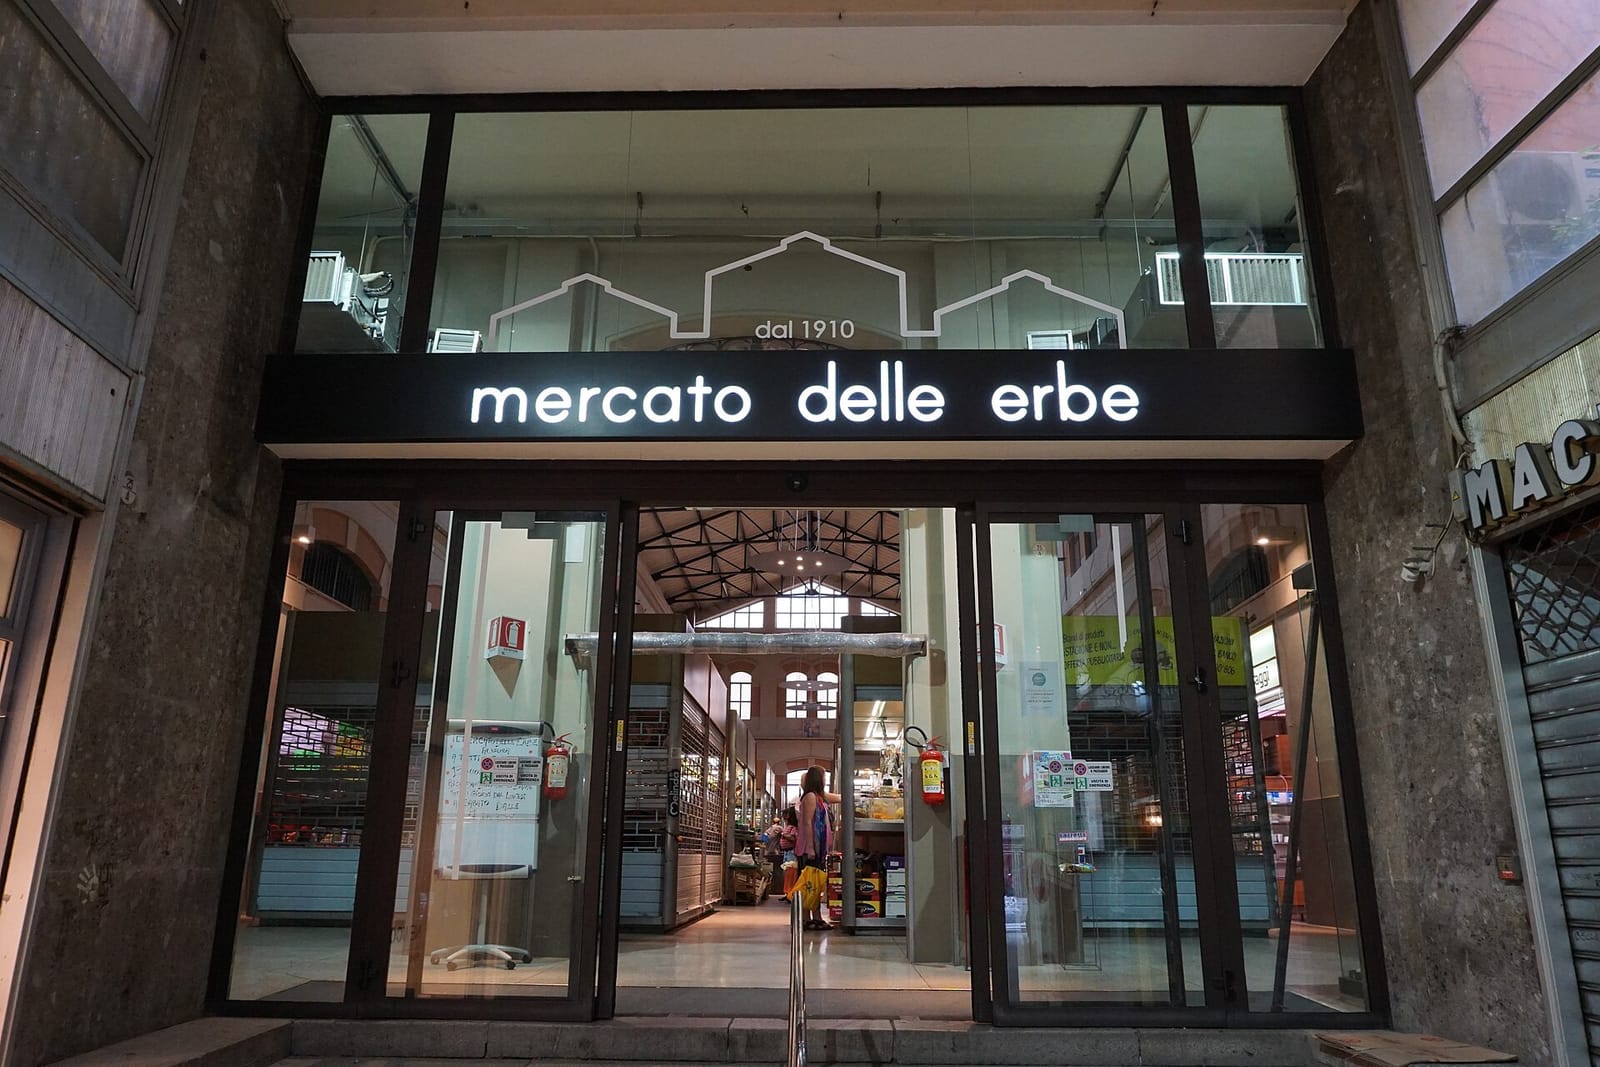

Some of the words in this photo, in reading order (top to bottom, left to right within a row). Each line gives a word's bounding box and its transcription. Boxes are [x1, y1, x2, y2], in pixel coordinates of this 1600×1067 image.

[755, 319, 794, 340] dal
[801, 319, 855, 340] 1910
[470, 375, 752, 424] mercato
[797, 360, 945, 423] delle
[991, 360, 1140, 423] erbe
[1464, 403, 1600, 529] MAC
